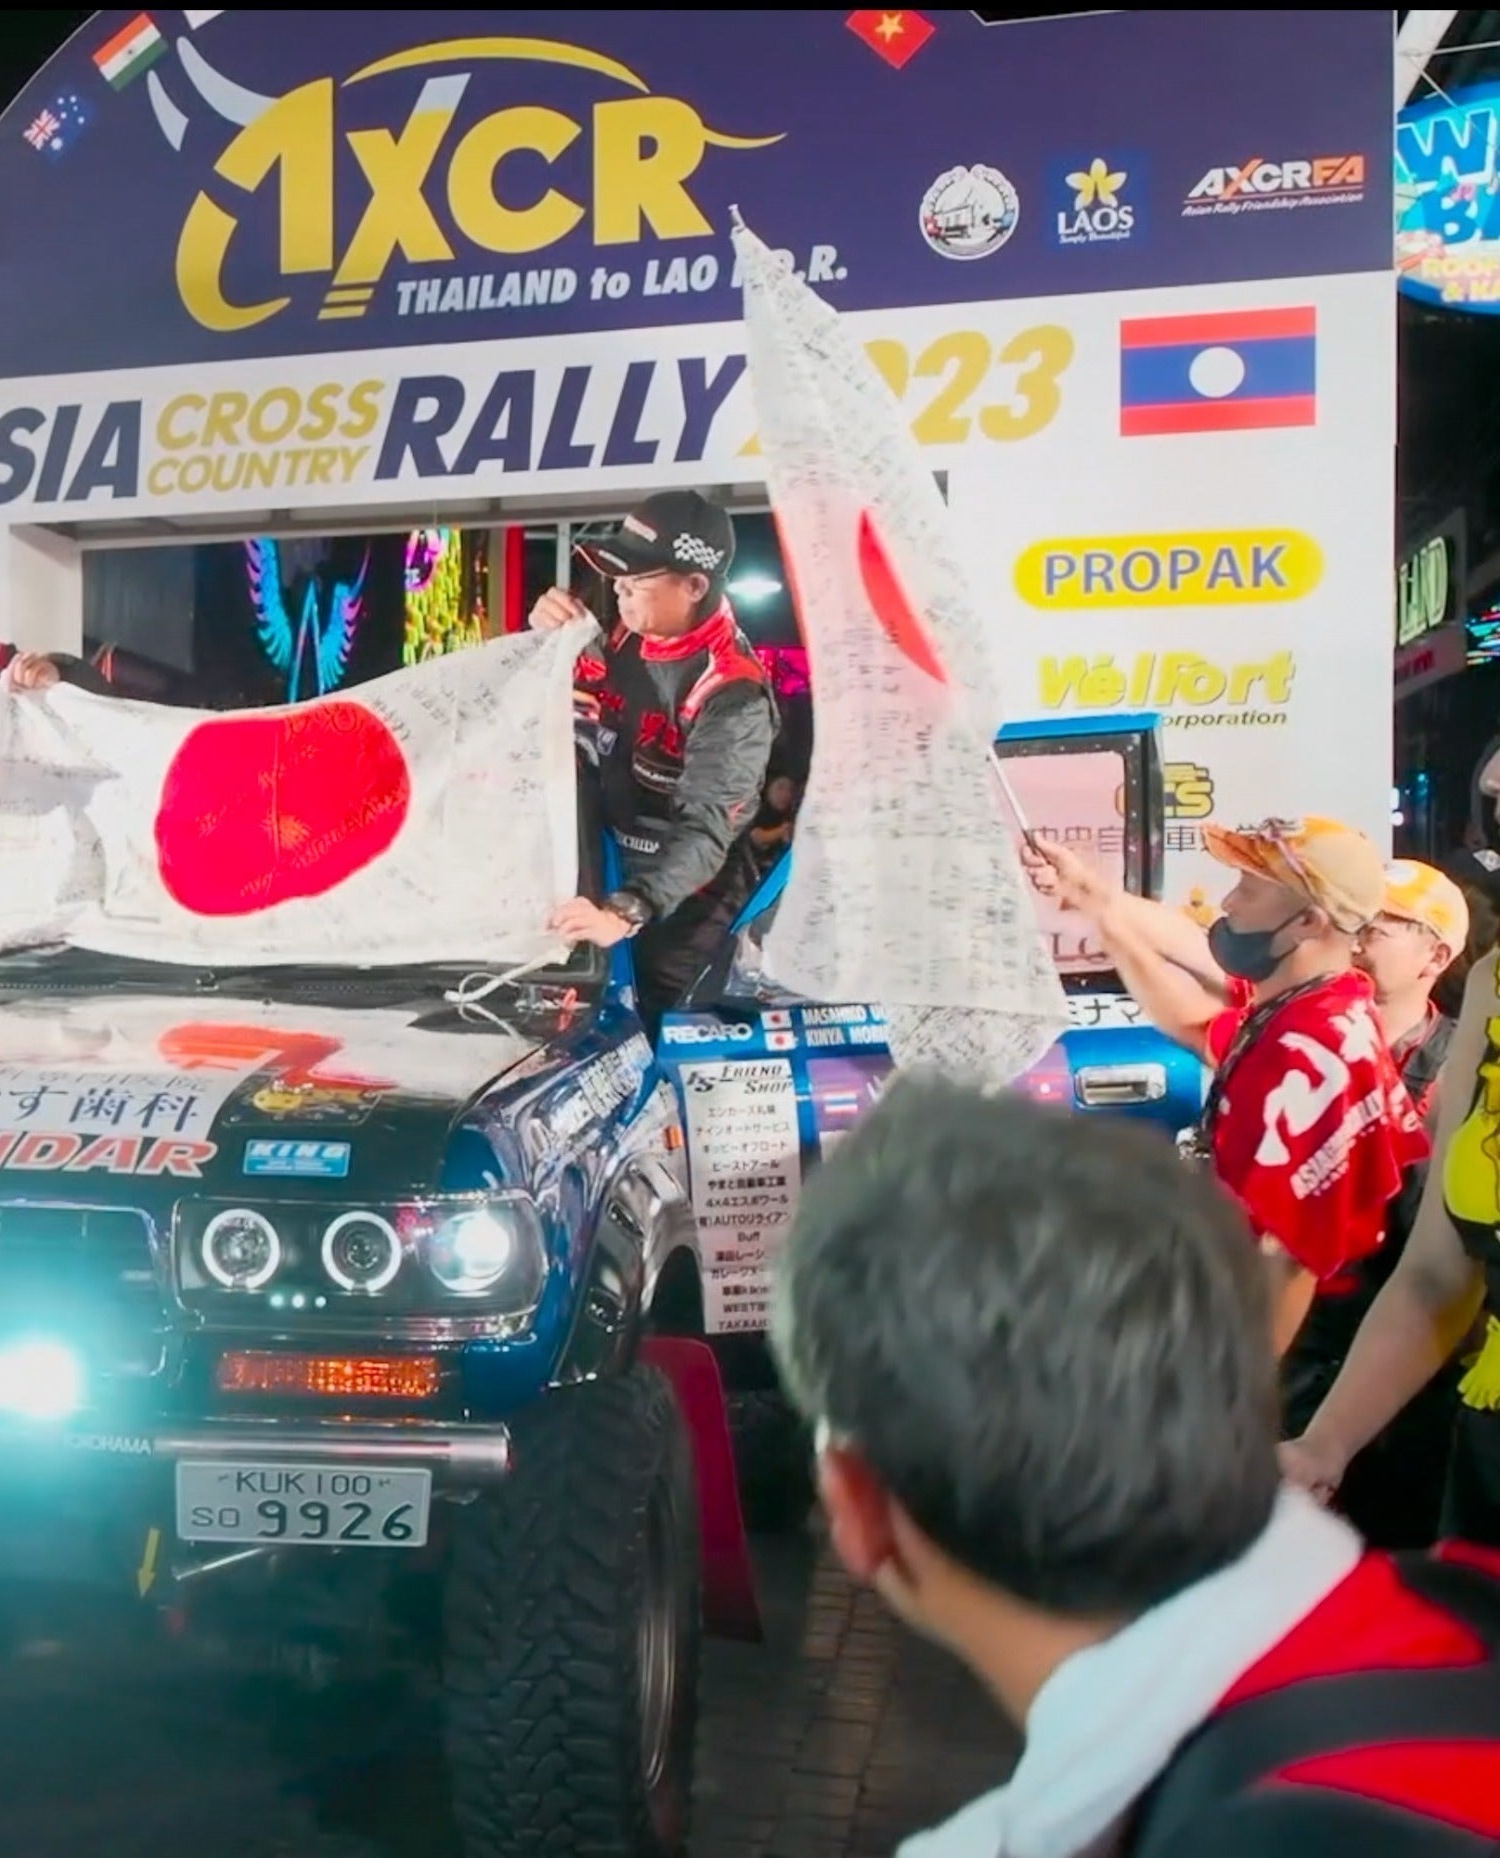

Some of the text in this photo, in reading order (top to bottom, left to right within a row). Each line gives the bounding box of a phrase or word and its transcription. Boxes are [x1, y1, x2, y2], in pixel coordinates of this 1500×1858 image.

[1188, 155, 1365, 200] AXCRFA
[176, 72, 714, 331] AXCR
[1058, 206, 1135, 236] LAOS
[397, 268, 576, 316] THAILAND
[590, 267, 630, 299] to
[643, 254, 718, 296] LAO
[156, 379, 385, 451] CROSS
[374, 354, 747, 481] RALLY
[147, 445, 372, 497] COUNTRY
[1044, 544, 1288, 597] PROPAK
[1161, 709, 1288, 731] orporation
[662, 1022, 754, 1045] RECARO
[743, 1080, 794, 1095] SHOP
[63, 1433, 153, 1457] YOKOHAMA
[236, 1471, 372, 1496] KUK 100
[256, 1499, 414, 1542] 9926
